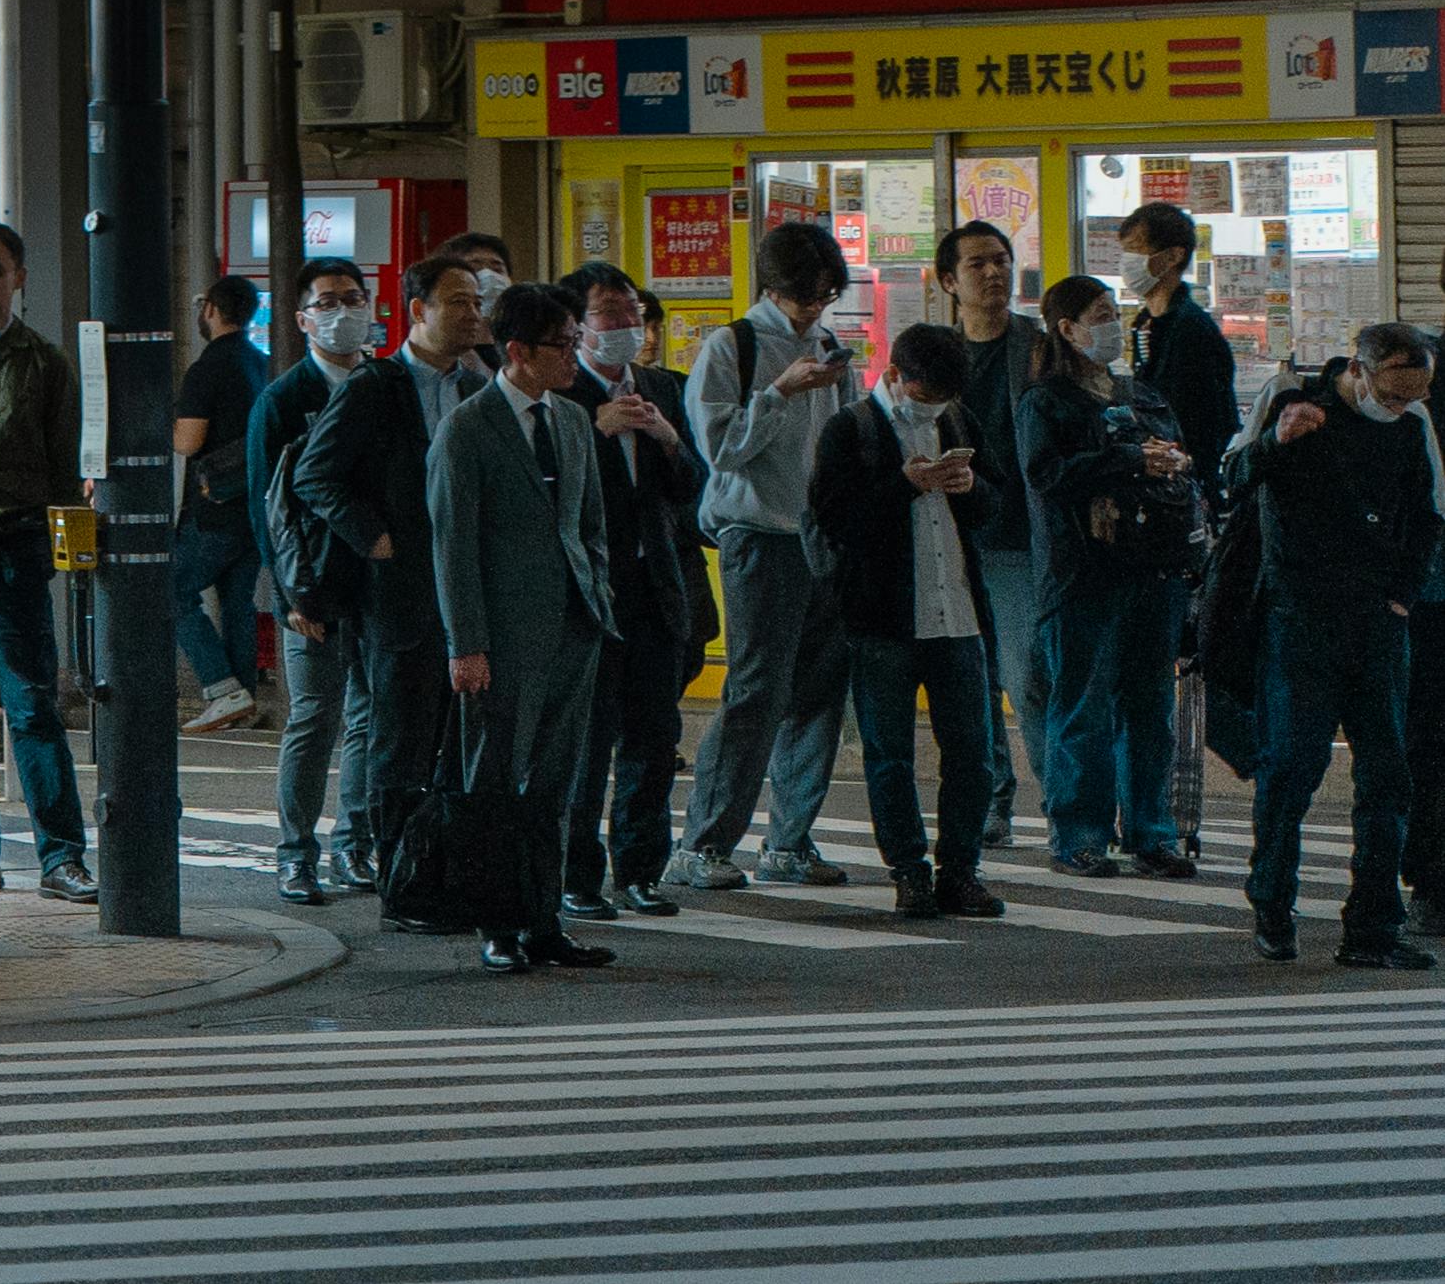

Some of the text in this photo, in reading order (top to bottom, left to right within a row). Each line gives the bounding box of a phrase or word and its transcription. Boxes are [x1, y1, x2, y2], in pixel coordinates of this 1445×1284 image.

[482, 74, 539, 99] toto
[557, 72, 604, 99] BIG
[877, 49, 1147, 100] 秋葉原 大黒天宝くじ
[965, 184, 1031, 223] 1億円
[582, 232, 610, 251] BIG
[838, 225, 862, 240] BIG
